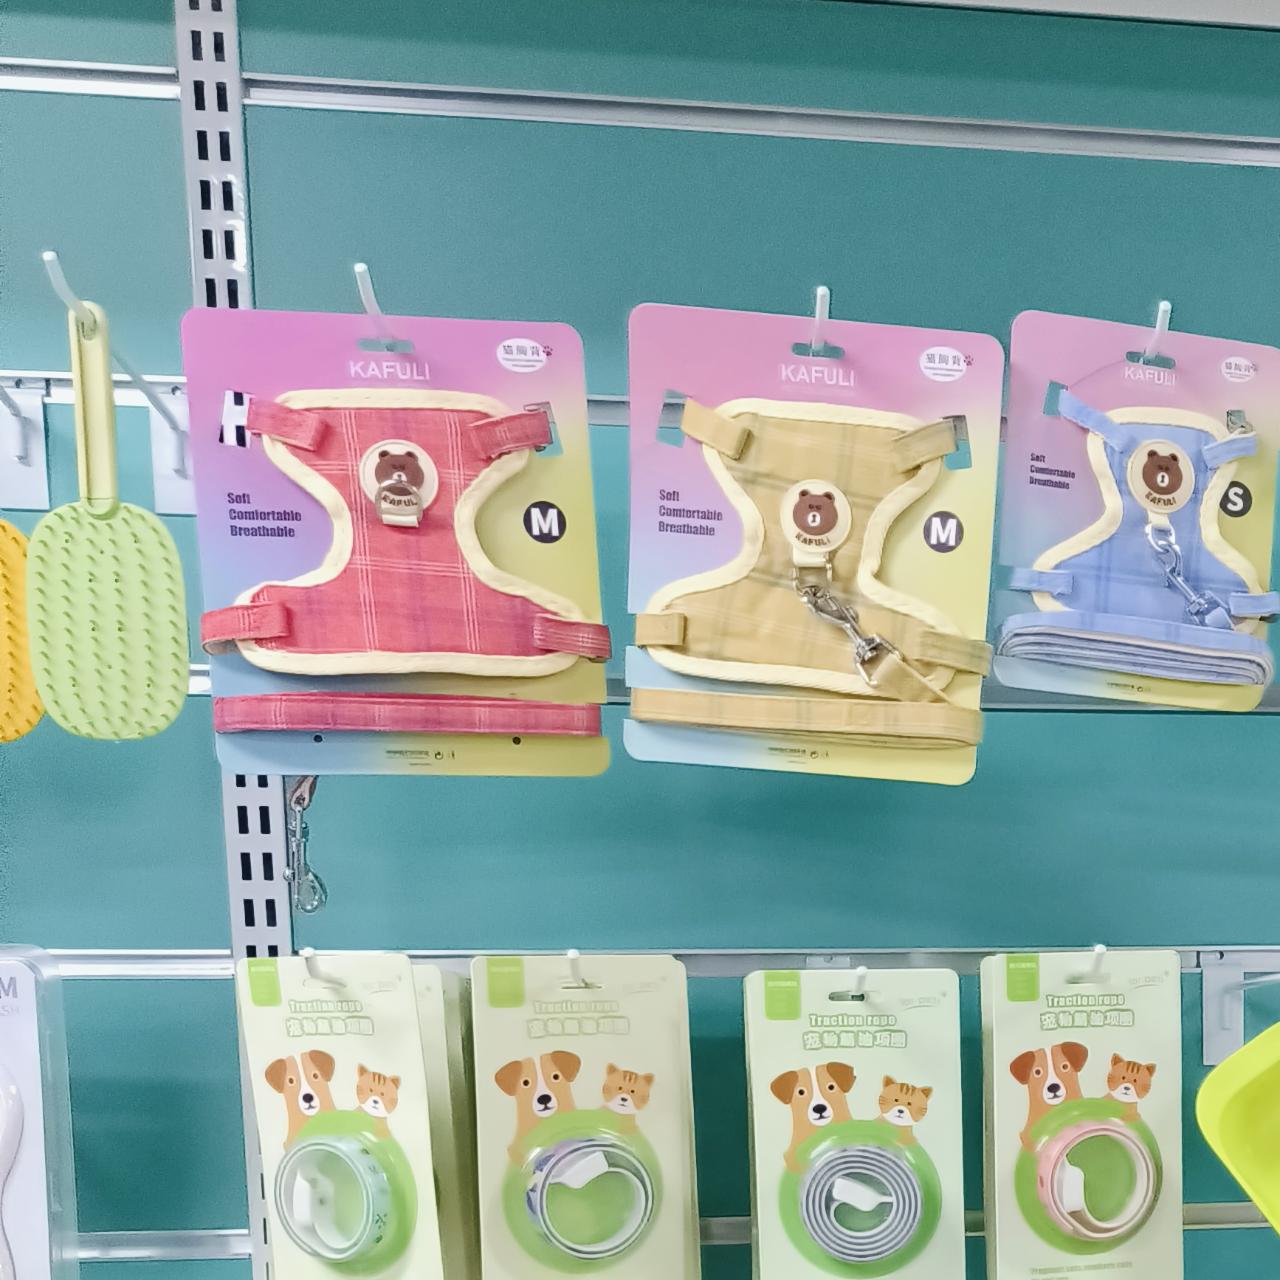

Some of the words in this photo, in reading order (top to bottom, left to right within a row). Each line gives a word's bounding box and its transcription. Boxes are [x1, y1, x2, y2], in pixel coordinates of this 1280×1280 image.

[350, 360, 430, 380] KAFULI
[780, 364, 855, 387] KAFULI
[1124, 366, 1176, 386] KAFULI
[227, 492, 251, 504] Soft
[659, 489, 680, 502] Soft
[1226, 486, 1244, 511] S
[229, 508, 302, 521] Comfortable
[530, 507, 560, 537] M
[659, 505, 723, 521] Comfortable
[230, 525, 296, 538] Breathable
[658, 521, 715, 536] Breathable
[930, 517, 958, 546] M
